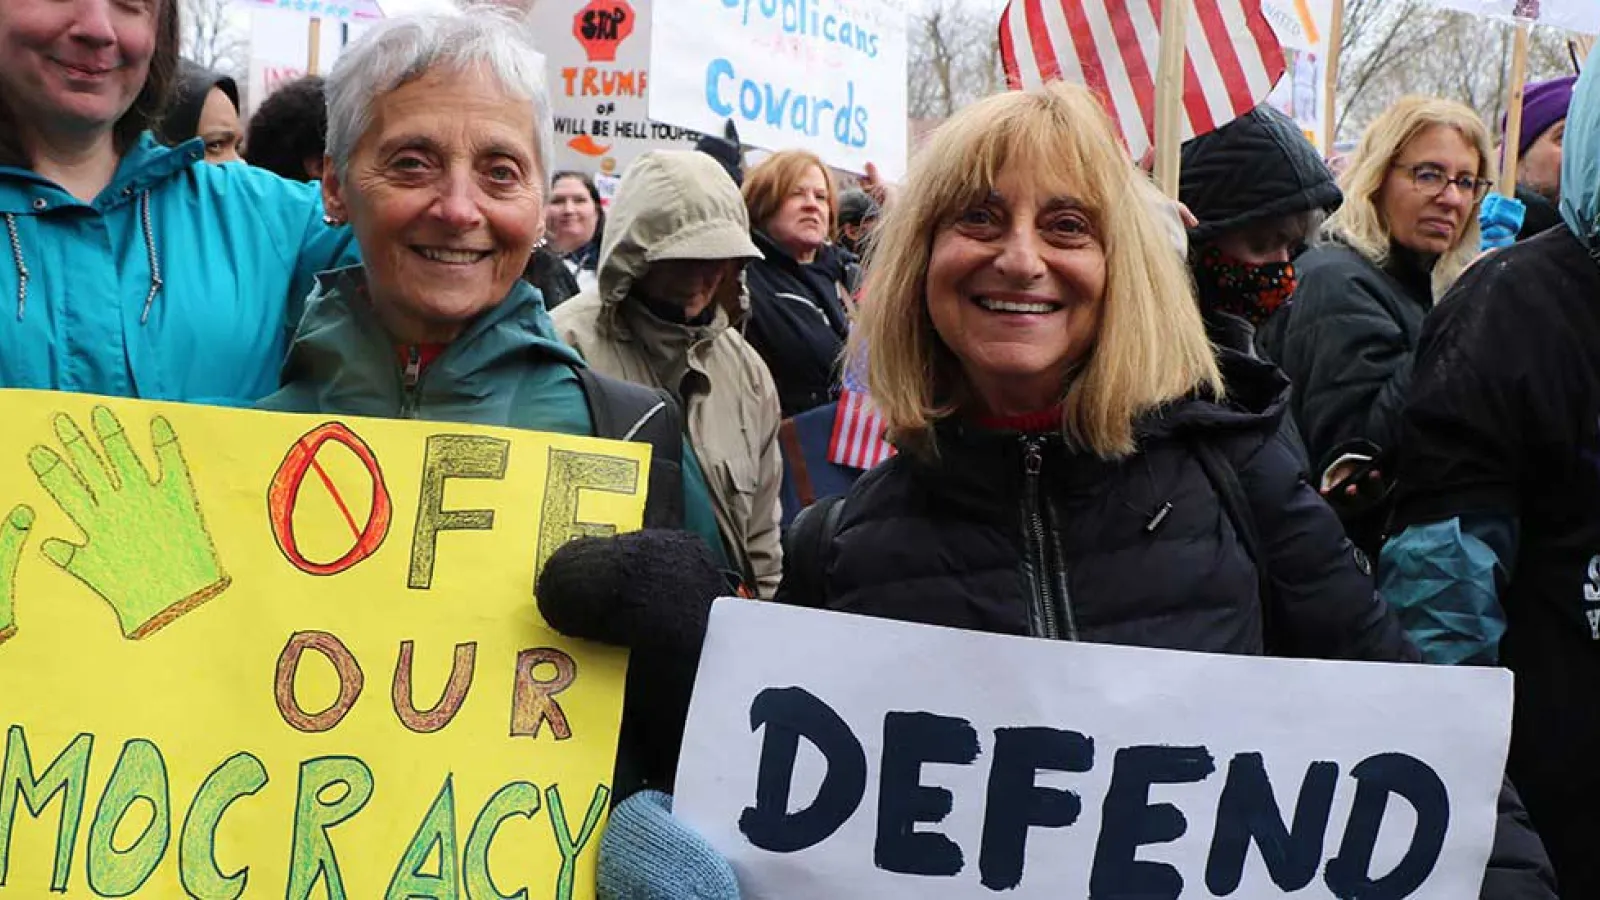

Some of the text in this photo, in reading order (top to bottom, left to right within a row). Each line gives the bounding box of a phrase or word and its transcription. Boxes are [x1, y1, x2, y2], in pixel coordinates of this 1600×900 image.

[581, 7, 627, 40] STOP
[553, 117, 586, 136] WILL
[591, 119, 609, 138] BE
[615, 120, 647, 139] HELL
[705, 57, 869, 148] Cowards
[268, 421, 639, 596] OFF
[274, 630, 577, 740] OUR
[0, 725, 611, 900] MOCRACY
[738, 686, 1450, 900] DEFEND
